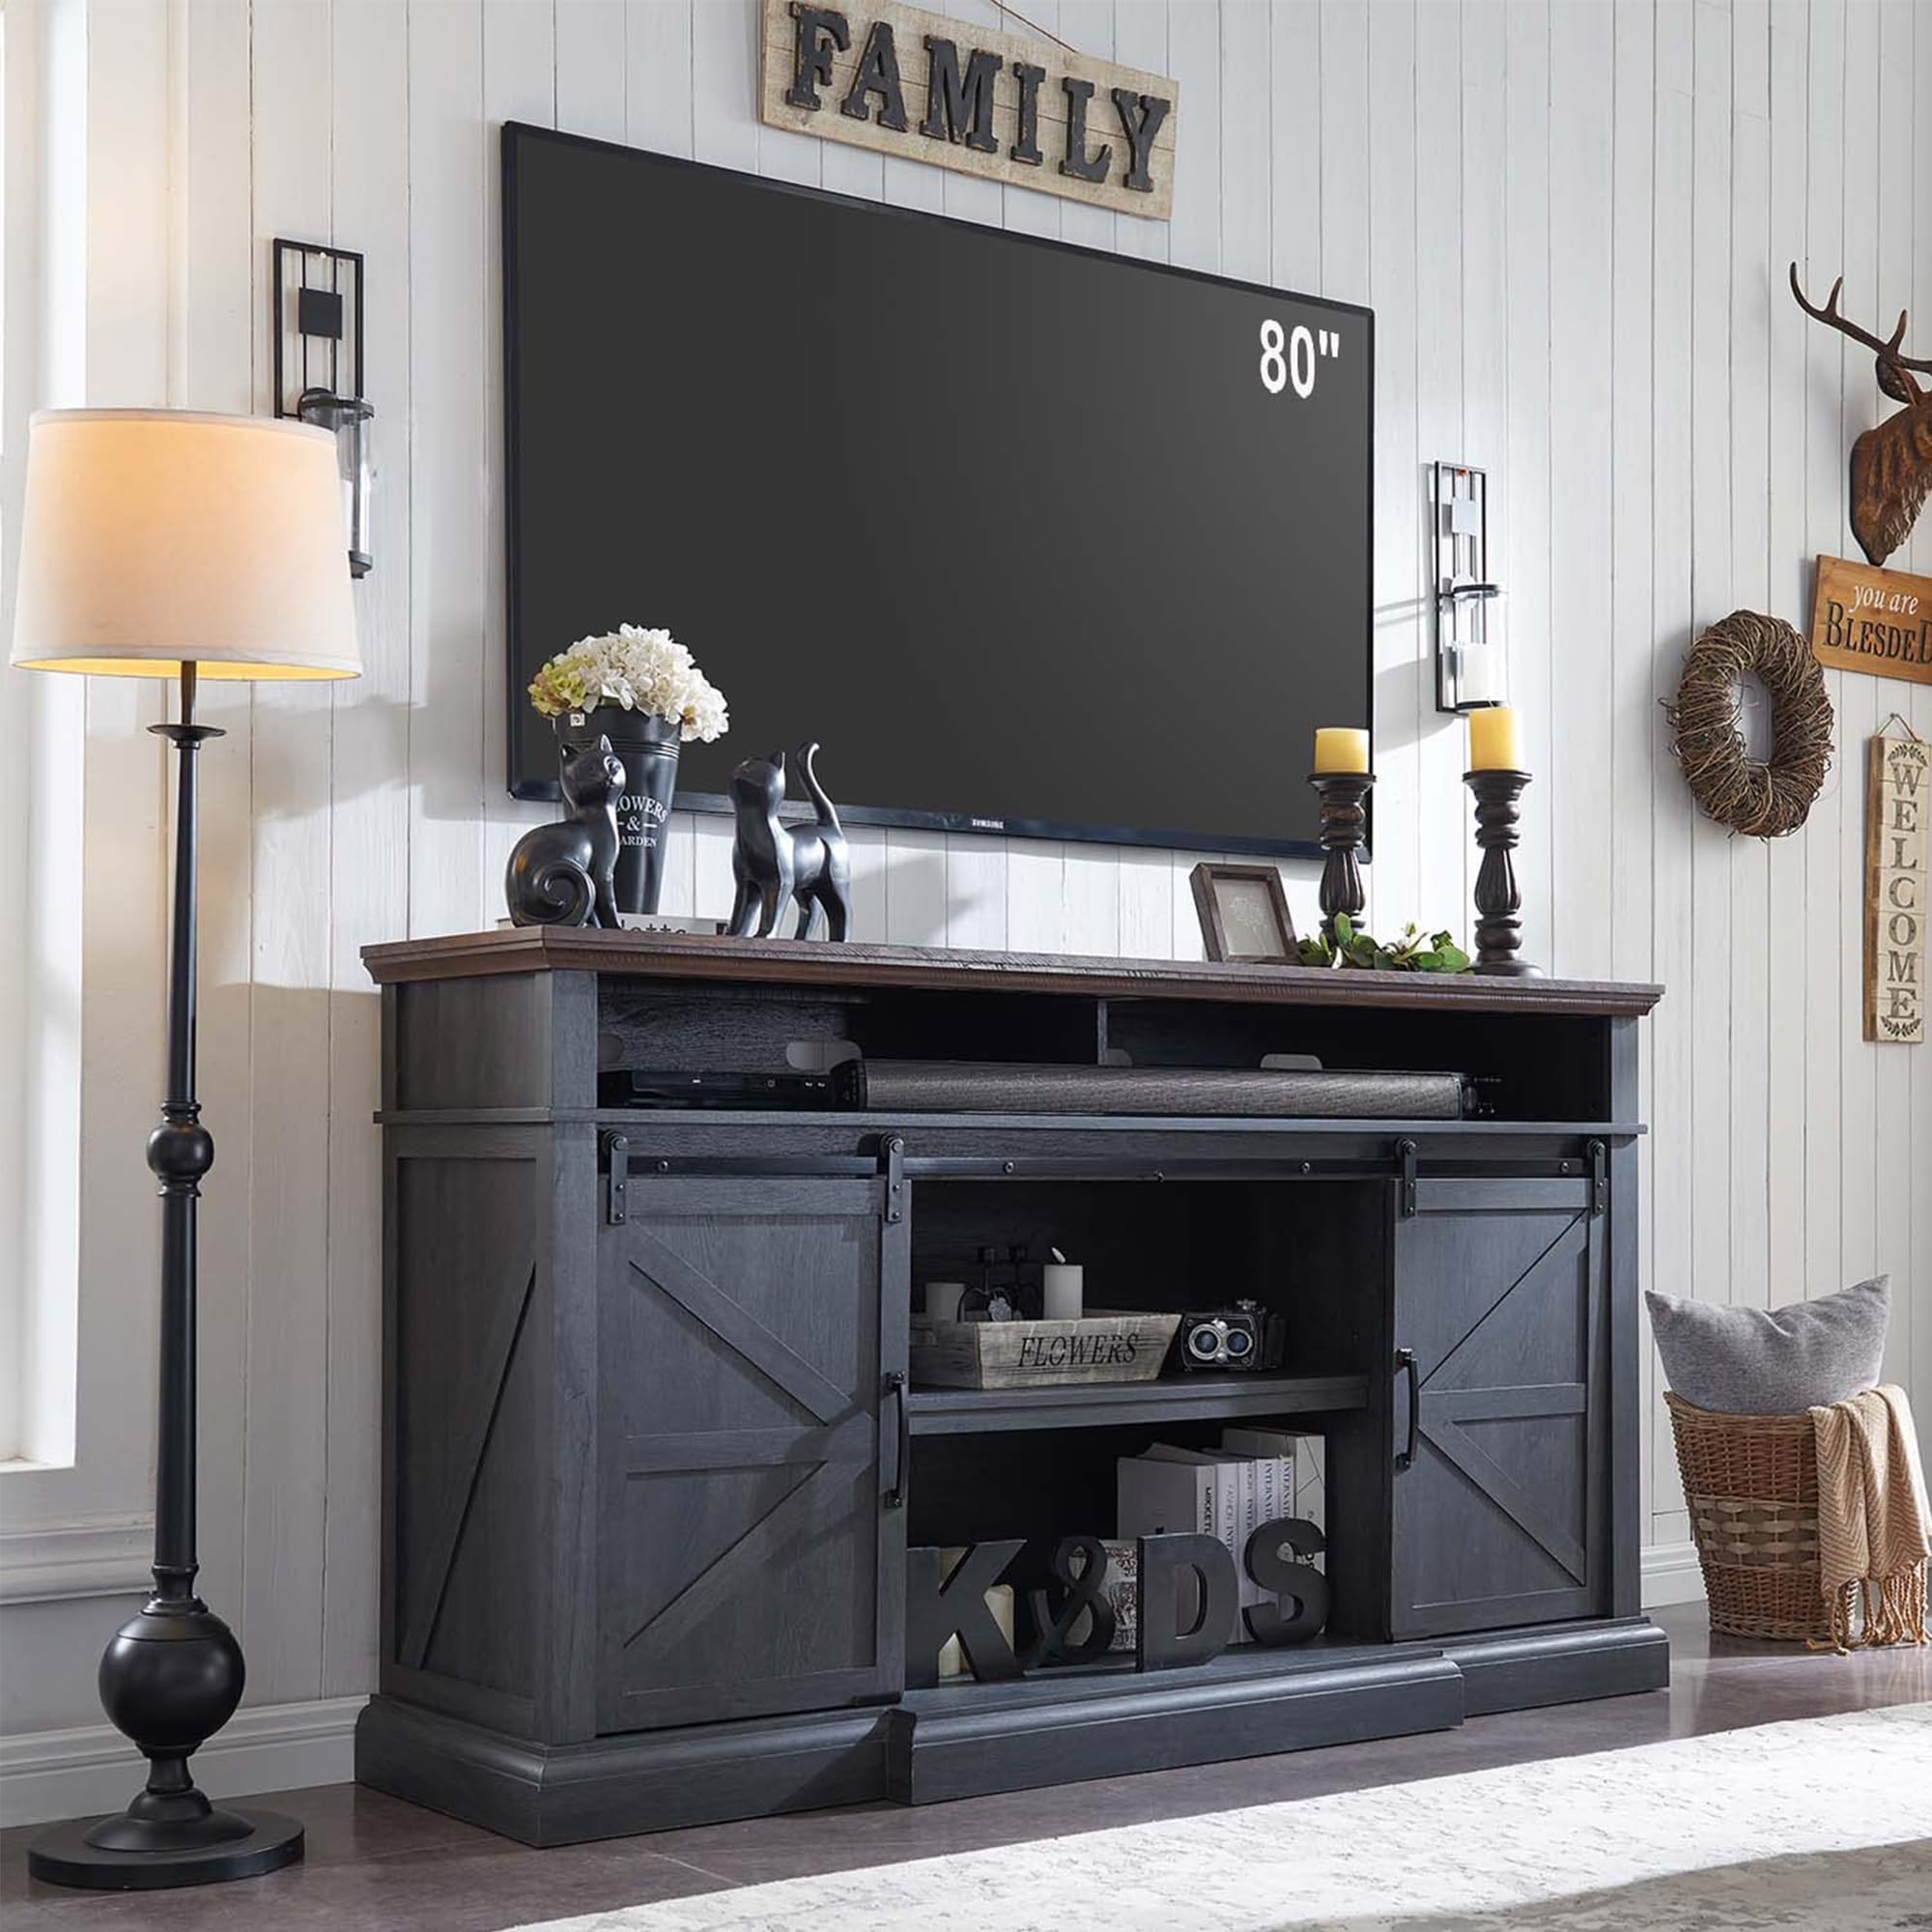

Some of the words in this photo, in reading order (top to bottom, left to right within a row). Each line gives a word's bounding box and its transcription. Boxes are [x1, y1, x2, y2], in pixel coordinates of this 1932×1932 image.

[785, 1, 1170, 192] FAMILY
[1848, 584, 1887, 613] you
[1889, 593, 1919, 615] are
[616, 795, 668, 823] OWERS
[626, 815, 640, 832] &
[619, 836, 658, 848] ARDEN
[1888, 761, 1922, 1020] WELCOME
[1017, 1332, 1140, 1369] FLOWERS
